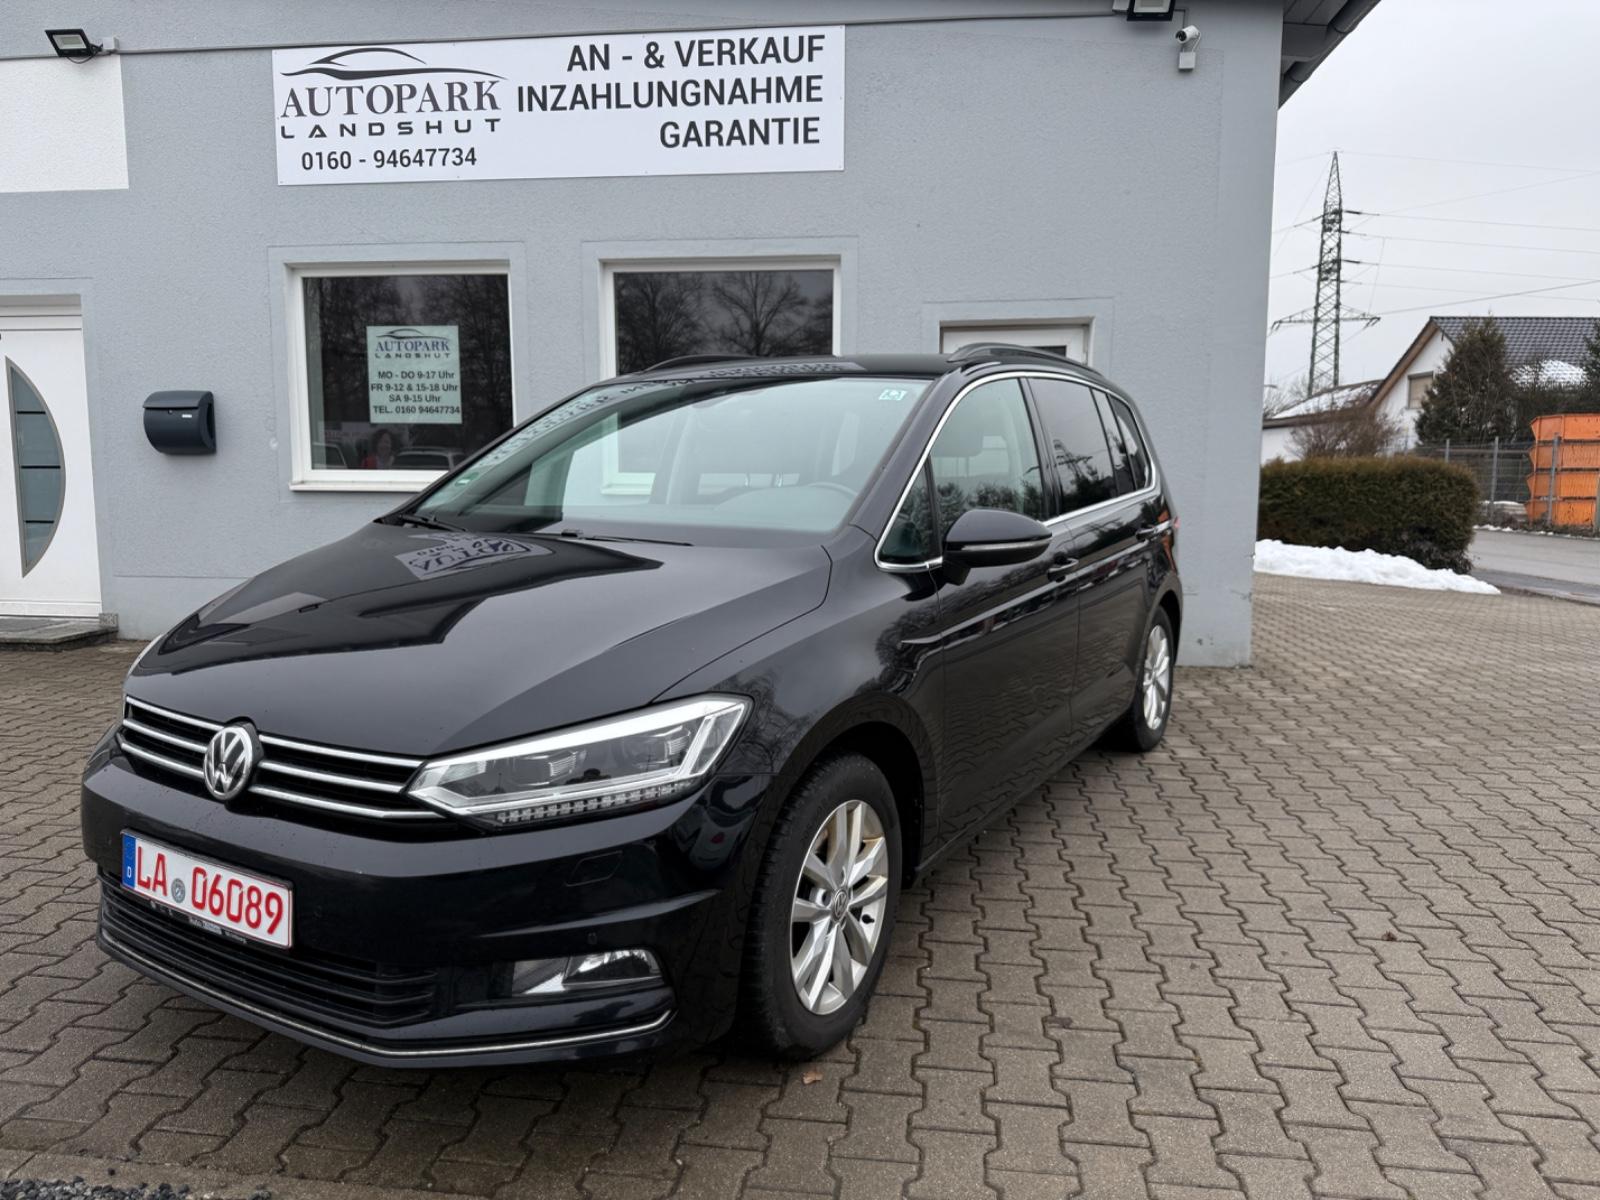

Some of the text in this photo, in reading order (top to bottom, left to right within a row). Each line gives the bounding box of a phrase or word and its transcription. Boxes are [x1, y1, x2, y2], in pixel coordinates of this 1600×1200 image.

[566, 44, 610, 72] AN
[644, 41, 665, 69] &
[674, 35, 825, 69] VERKAUF
[280, 80, 502, 118] AUTOPARK
[517, 75, 823, 113] INZAHLUNGNAHME
[280, 118, 501, 139] LANDSHUT
[659, 117, 820, 149] GARANTIE
[301, 151, 352, 171] 0160
[373, 147, 477, 169] 94647734
[375, 340, 450, 352] AUTOPARK
[378, 371, 393, 380] MO
[400, 371, 415, 379] DO
[417, 371, 436, 379] 9-17
[438, 370, 455, 379] Uhr
[370, 383, 458, 392] FR 9-12 & 15-18 Uhr
[388, 394, 441, 403] SA 9-15 Uhr
[373, 405, 460, 415] TEL. 0160 94647734
[136, 846, 168, 897] LA
[191, 866, 283, 935] 06089
